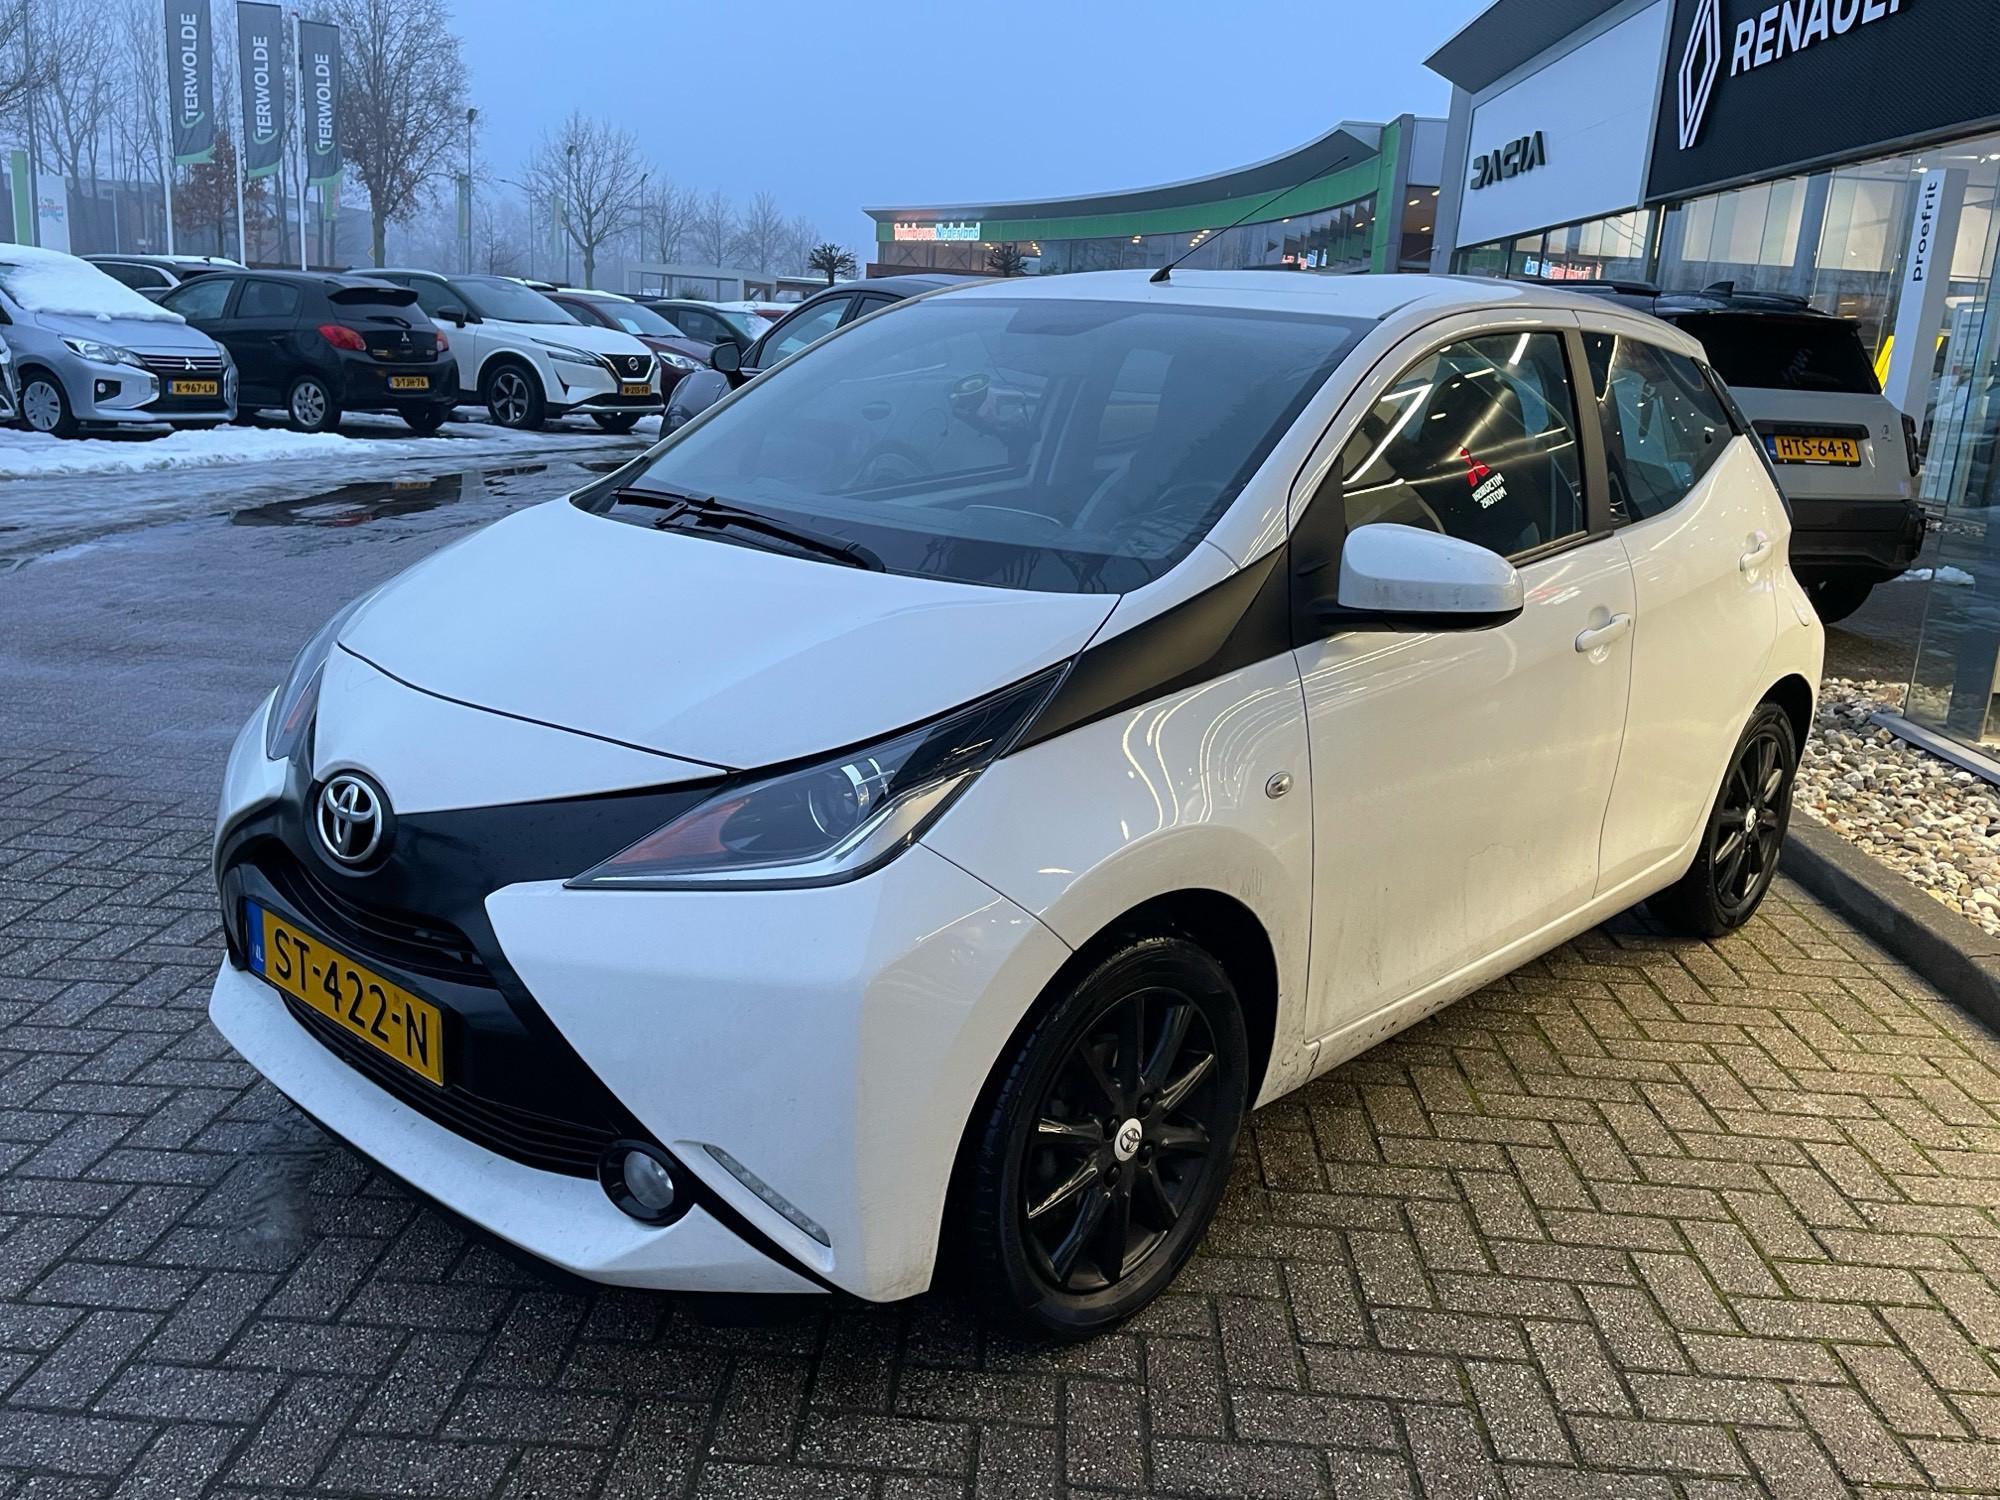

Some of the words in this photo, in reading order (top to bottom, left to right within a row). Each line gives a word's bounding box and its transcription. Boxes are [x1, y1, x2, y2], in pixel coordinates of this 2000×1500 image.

[180, 13, 199, 120] TERWOLDE
[1730, 0, 1899, 77] RENAUL
[252, 36, 273, 137] TERWOLDE
[314, 53, 333, 148] TERWOLDE
[1470, 130, 1546, 190] DACIA
[1912, 182, 1938, 281] proefrit
[175, 383, 215, 393] K-967-LH
[1780, 439, 1853, 458] HTS-64-R
[274, 928, 428, 1067] ST-422-N
